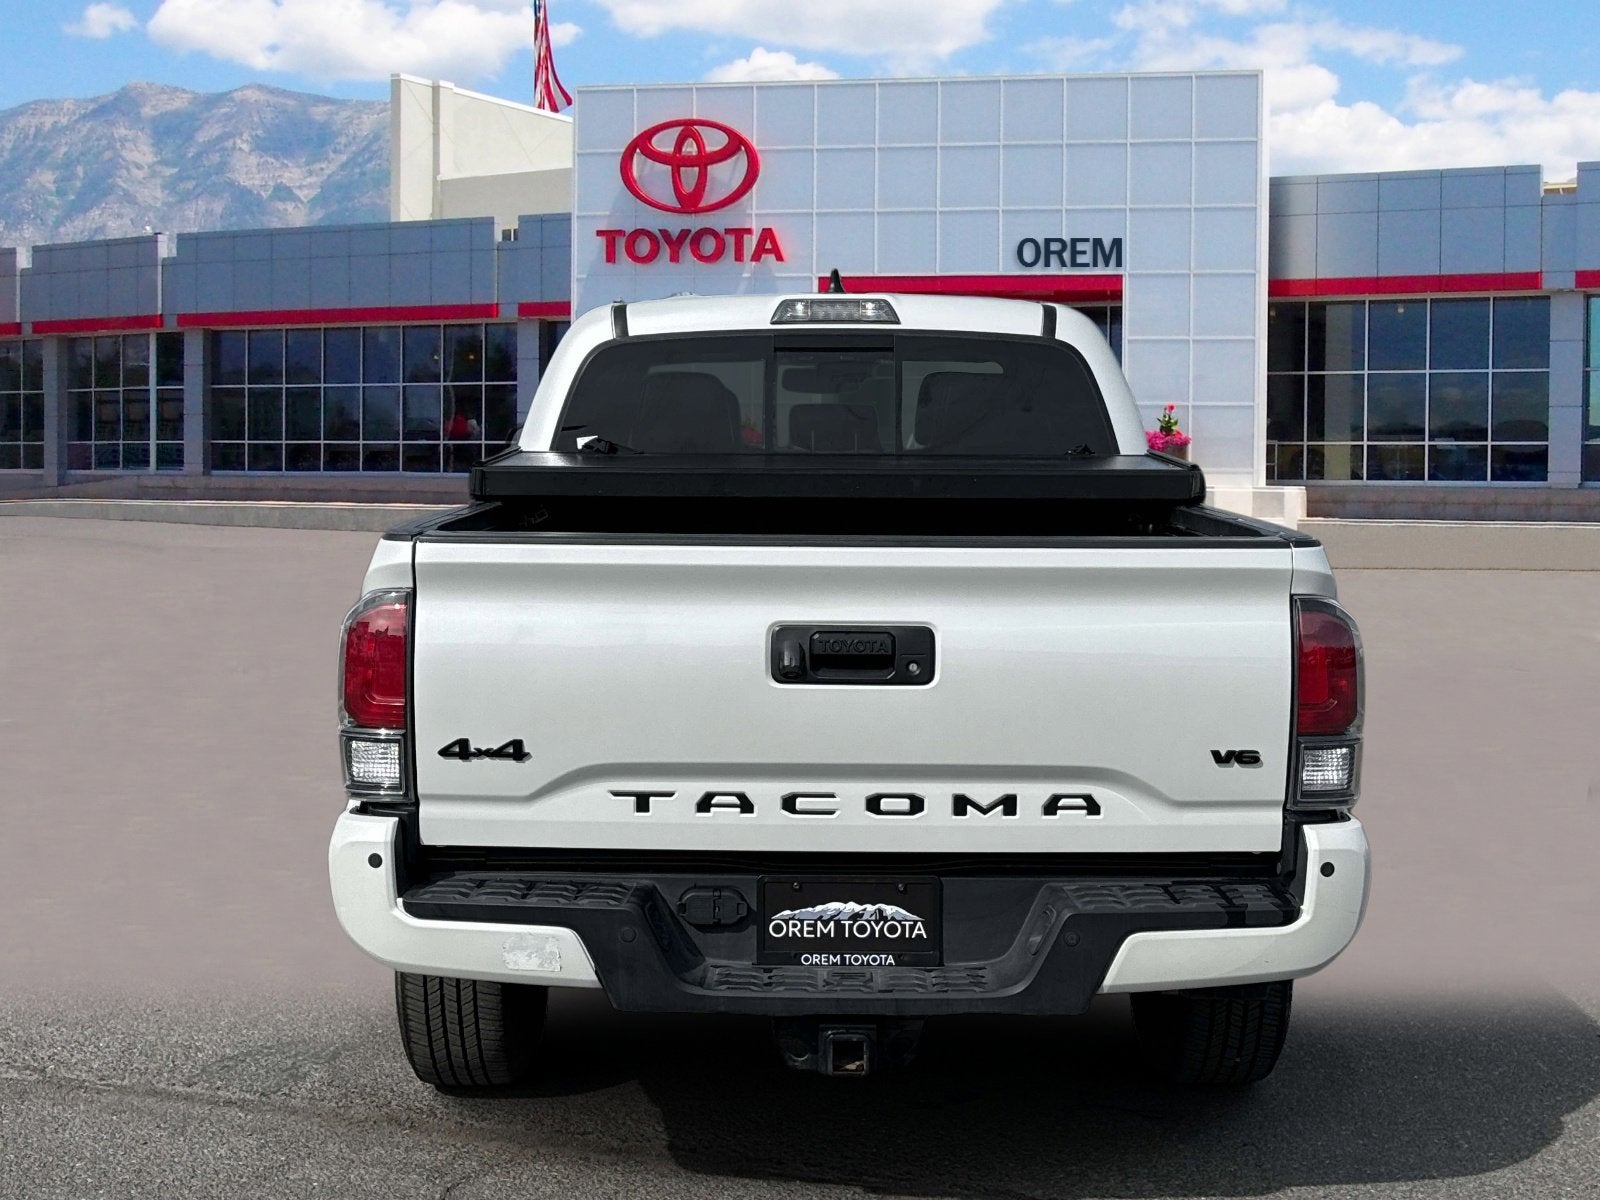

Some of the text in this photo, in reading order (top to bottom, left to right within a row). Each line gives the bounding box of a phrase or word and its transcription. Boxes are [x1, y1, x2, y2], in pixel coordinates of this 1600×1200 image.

[596, 226, 785, 265] TOYOTA
[1016, 236, 1124, 269] OREM
[818, 638, 889, 654] TOYOTA
[437, 737, 532, 763] 4x4
[1209, 749, 1262, 768] V6
[607, 789, 1104, 819] TACOMA
[768, 919, 928, 939] OREM TOYOTA
[800, 953, 896, 966] OREM TOYOTA
